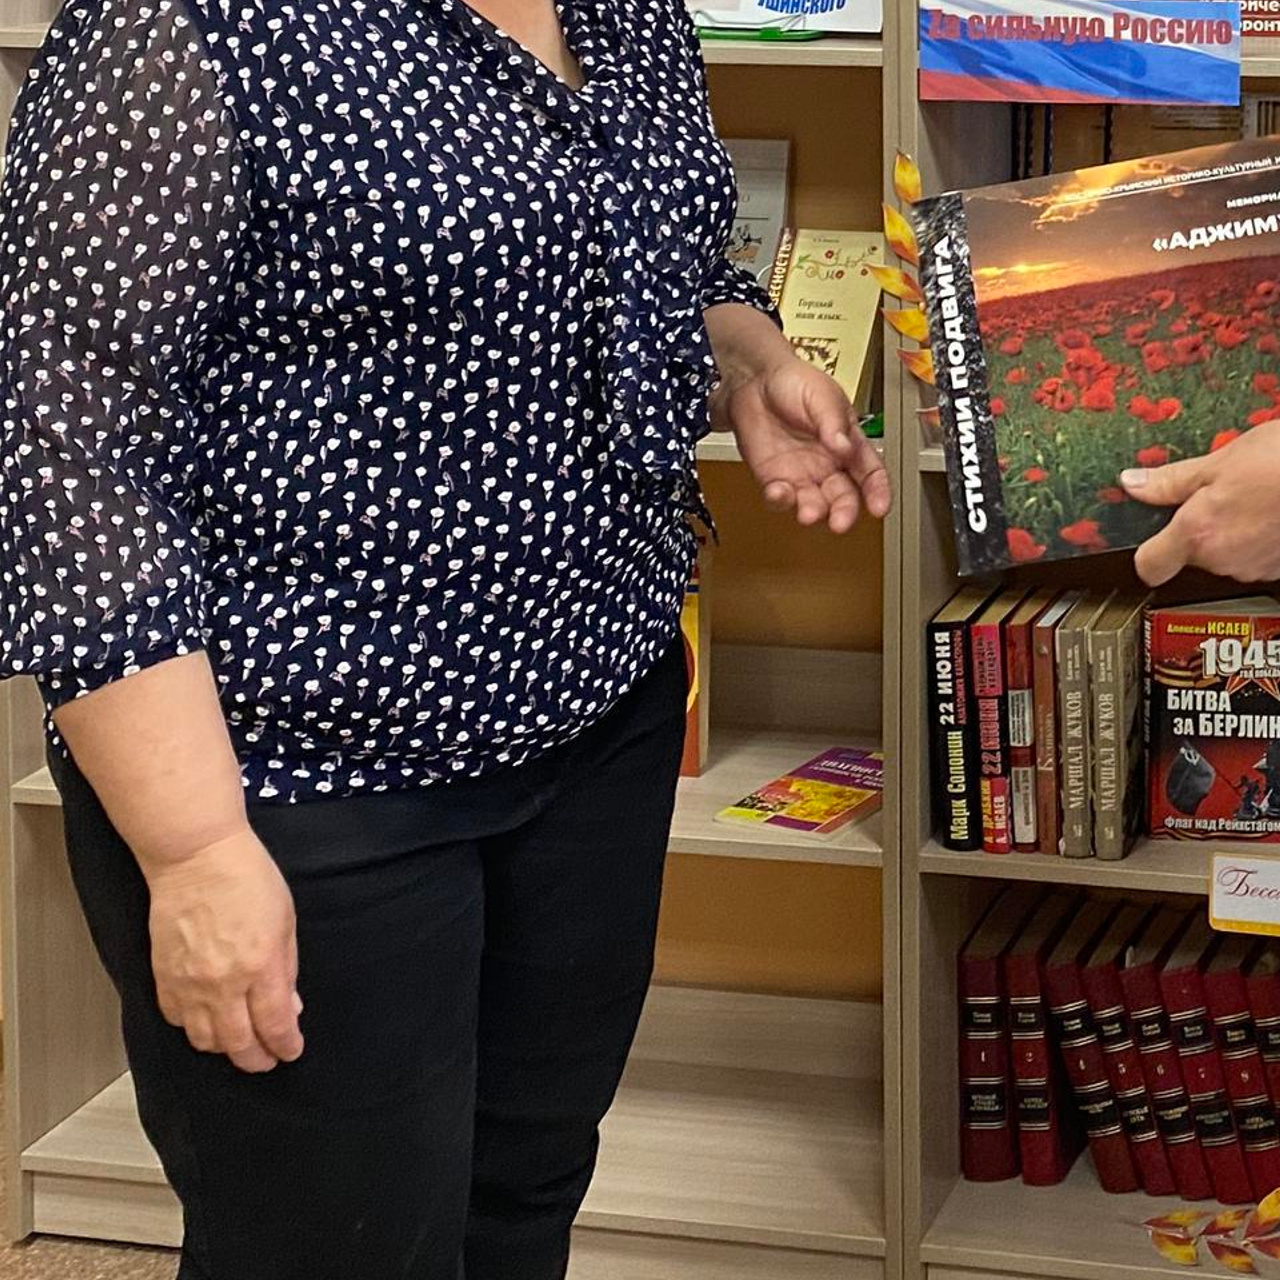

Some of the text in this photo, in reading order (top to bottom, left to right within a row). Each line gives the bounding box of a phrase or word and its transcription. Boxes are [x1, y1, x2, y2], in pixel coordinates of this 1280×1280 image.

[969, 12, 1105, 46] сильную
[1113, 11, 1233, 45] Россию
[933, 234, 988, 534] СТИХИИ ПОДВИГА
[1207, 621, 1250, 636] ИСАЕВ
[934, 631, 955, 726] 22 ИЮНЯ
[1167, 688, 1232, 713] БИТВА
[979, 699, 1002, 775] 22 ИЮНЯ
[1066, 690, 1083, 739] ЖУКОВ
[1099, 693, 1115, 741] ЖУКОВ
[947, 730, 970, 840] Марк Солонин
[1068, 746, 1085, 809] МАРШАЛ
[1100, 748, 1116, 811] МАРШАЛ
[1164, 817, 1192, 832] Флаг
[1194, 819, 1217, 832] над
